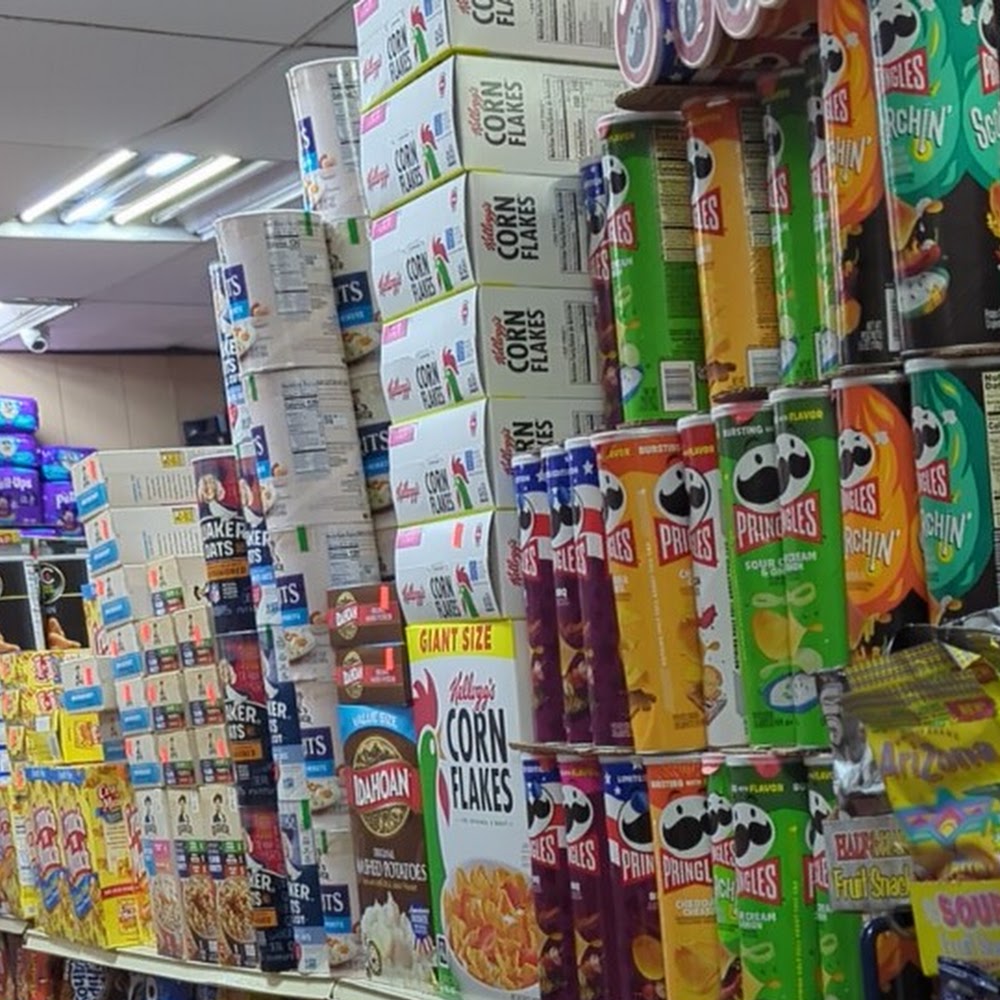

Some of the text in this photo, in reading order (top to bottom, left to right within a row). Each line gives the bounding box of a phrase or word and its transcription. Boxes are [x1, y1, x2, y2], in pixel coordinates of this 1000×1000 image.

[387, 25, 408, 61] CORN
[390, 53, 412, 82] FLAKES
[482, 81, 506, 146] CORN
[501, 81, 526, 147] FLAKES
[395, 141, 418, 172] CORN
[400, 165, 424, 193] FLAKES
[494, 196, 519, 260] CORN
[514, 195, 539, 260] FLAKES
[406, 252, 429, 283] CORN
[412, 275, 435, 303] FLAKES
[504, 309, 529, 373] CORN
[524, 309, 549, 372] FLAKES
[416, 361, 439, 390] CORN
[420, 385, 445, 410] FLAKES
[789, 409, 823, 422] FLAVOR
[425, 463, 449, 496] CORN
[430, 488, 455, 513] FLAKES
[845, 528, 900, 571] RCHIN'
[430, 573, 452, 598] CORN
[435, 597, 461, 618] FLAKES
[419, 626, 492, 653] GIANT SIZE
[449, 672, 495, 709] Kellogg's
[447, 709, 509, 763] CORN
[353, 768, 410, 805] IDAHOAN
[451, 768, 513, 812] FLAKES
[749, 783, 784, 793] FLAVOR
[384, 861, 427, 880] POTATOES
[663, 857, 712, 890] PRINGL
[832, 867, 869, 899] Fruit
